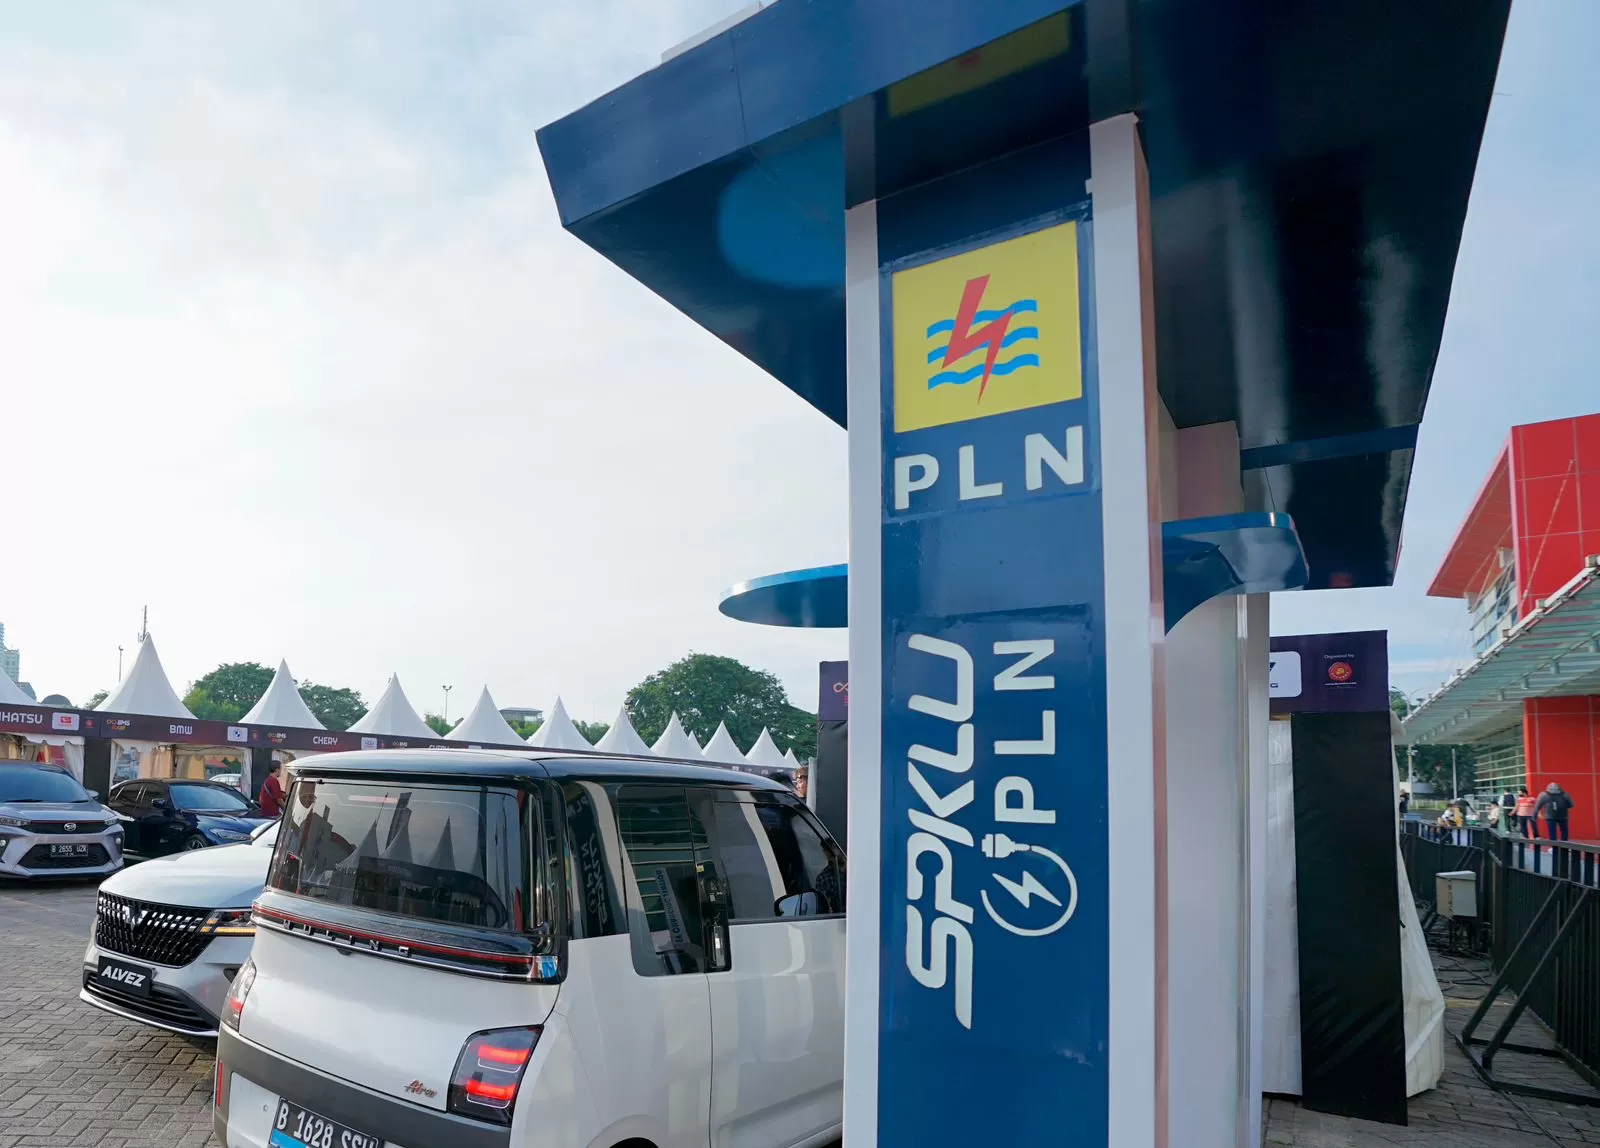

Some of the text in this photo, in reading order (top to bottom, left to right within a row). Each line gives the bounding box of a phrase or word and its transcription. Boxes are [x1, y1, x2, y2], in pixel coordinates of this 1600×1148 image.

[893, 425, 1084, 510] PLN
[169, 724, 193, 735] BMW
[312, 736, 338, 745] CHERY
[993, 639, 1057, 824] PLN
[906, 633, 975, 1030] SPKLU
[101, 965, 146, 987] ALVEZ
[276, 1102, 289, 1130] B
[293, 1110, 334, 1148] 1628
